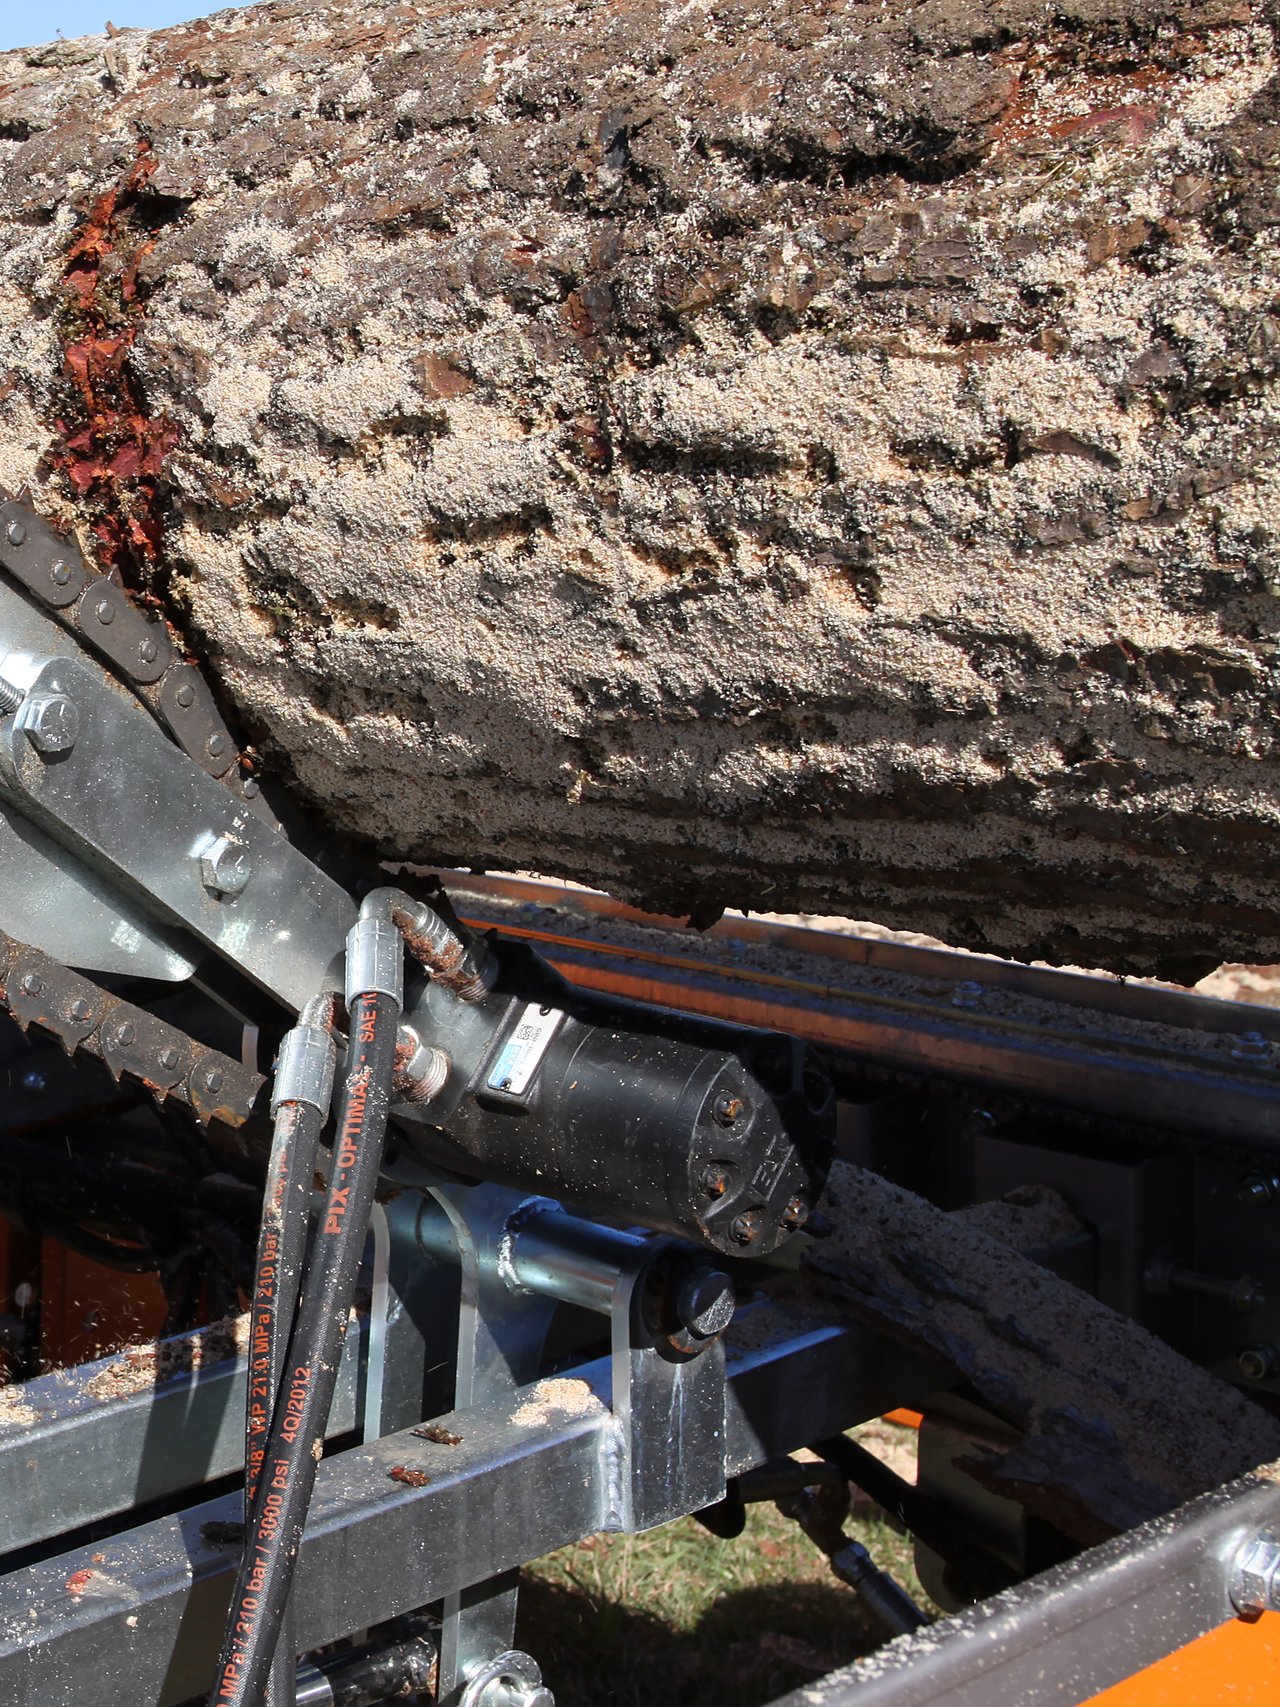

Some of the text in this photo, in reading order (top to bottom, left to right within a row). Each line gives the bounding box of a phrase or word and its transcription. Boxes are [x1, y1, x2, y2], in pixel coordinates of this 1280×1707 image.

[323, 1186, 350, 1234] PIX
[359, 1010, 377, 1043] SAE
[261, 1233, 277, 1261] bar
[258, 1266, 274, 1298] 210
[255, 1313, 270, 1353] MPa
[253, 1358, 268, 1397] 21.0
[251, 1403, 267, 1435] WP
[280, 1367, 312, 1444] 4Q/2012
[271, 1459, 290, 1489] psi
[258, 1494, 283, 1540] 3000
[246, 1557, 267, 1592] bar
[236, 1597, 259, 1635] 210
[219, 1653, 247, 1699] MPa
